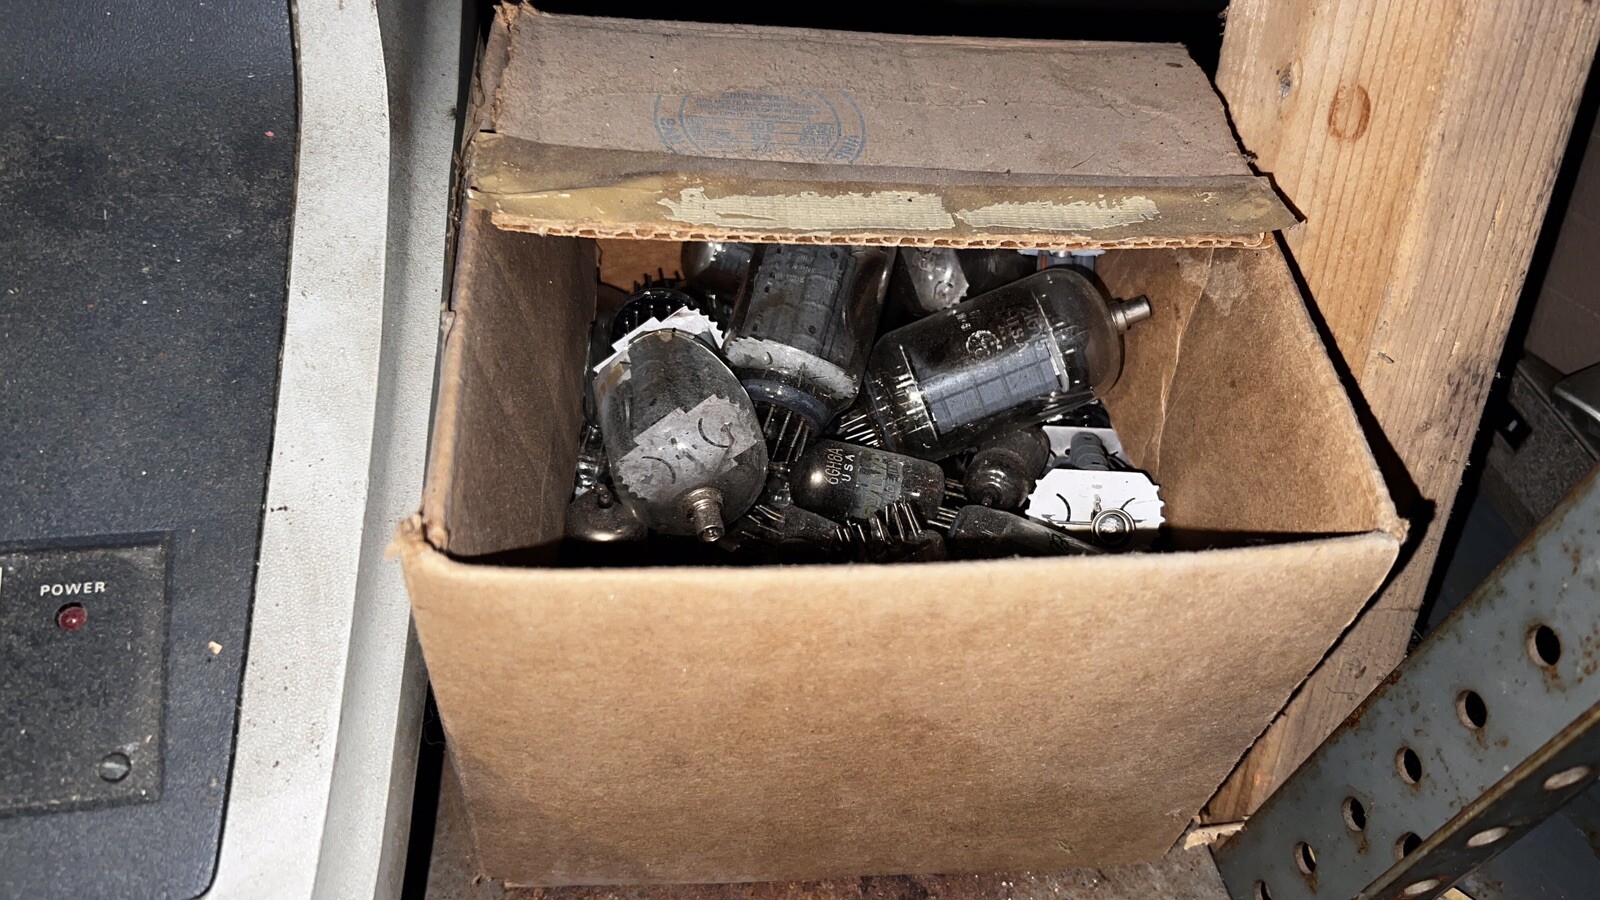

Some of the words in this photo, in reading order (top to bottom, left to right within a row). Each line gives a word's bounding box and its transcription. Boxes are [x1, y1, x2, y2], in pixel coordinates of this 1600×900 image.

[824, 448, 843, 485] 6GH8A
[841, 454, 855, 482] USA
[40, 581, 107, 596] POWER
